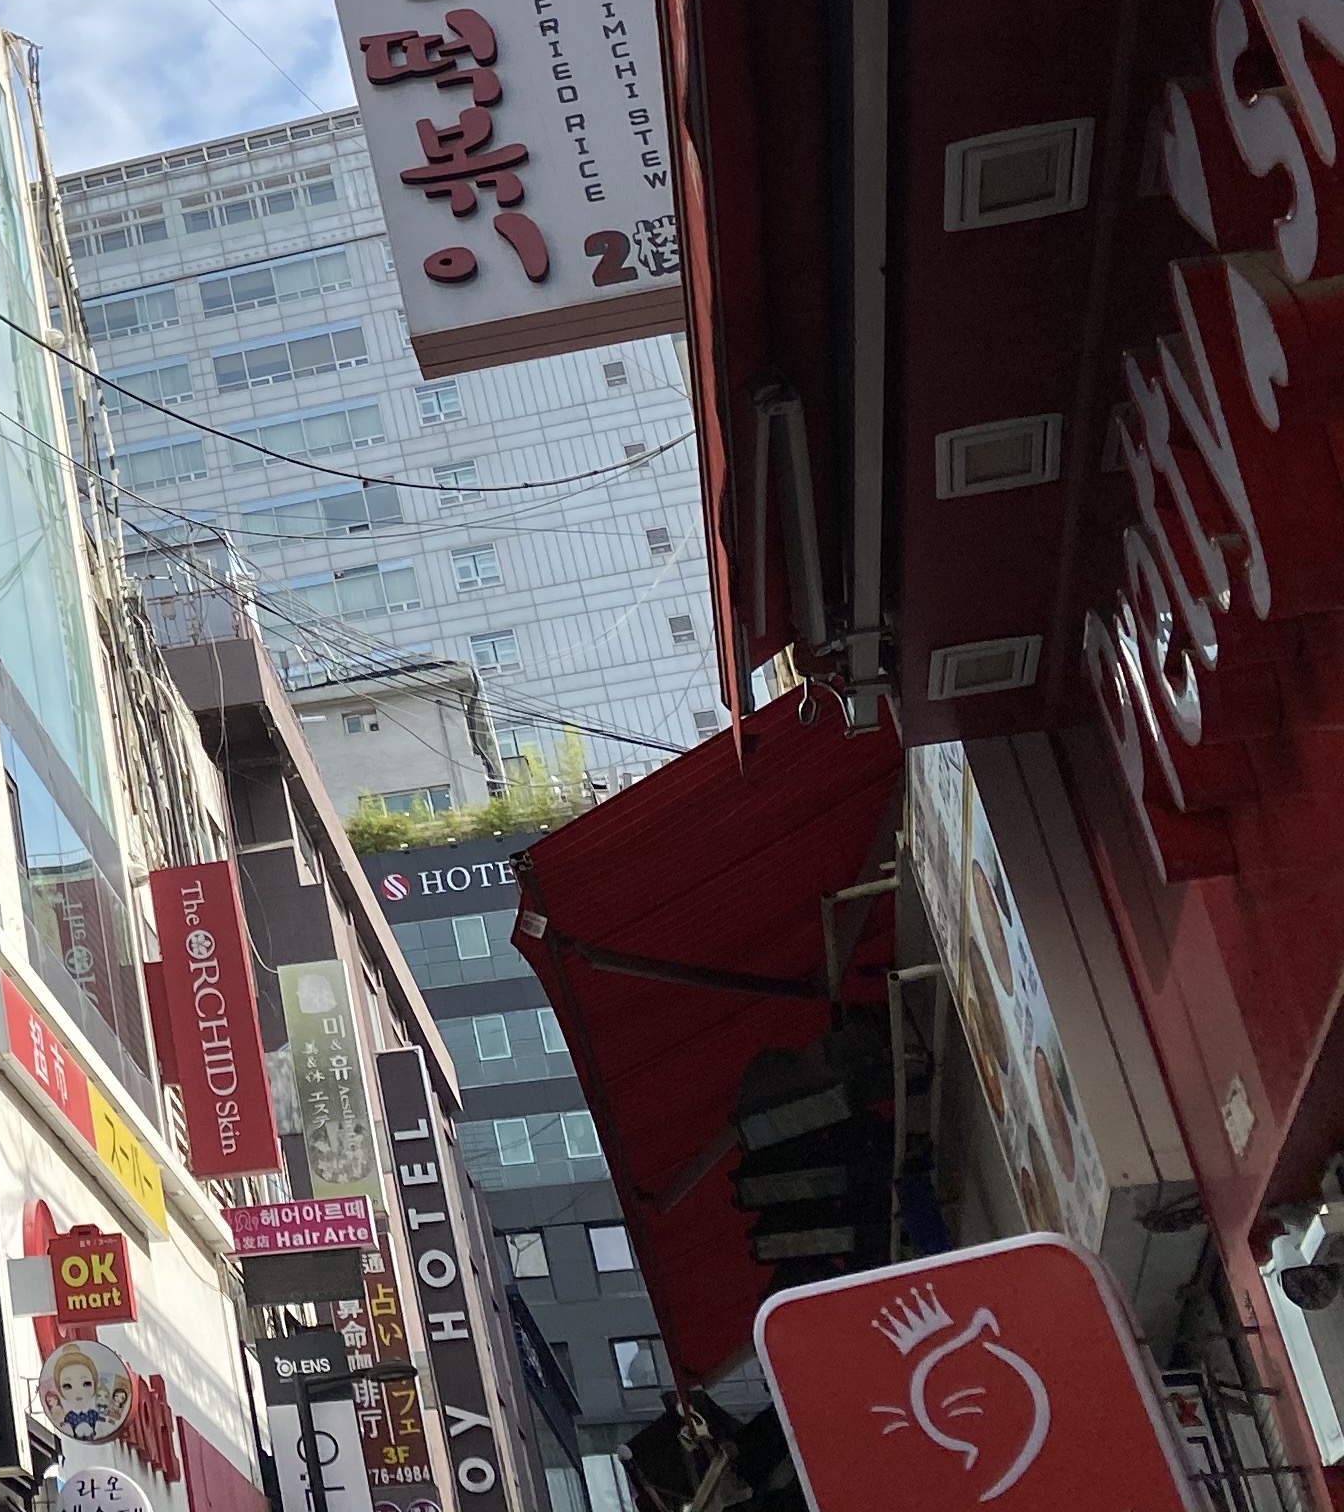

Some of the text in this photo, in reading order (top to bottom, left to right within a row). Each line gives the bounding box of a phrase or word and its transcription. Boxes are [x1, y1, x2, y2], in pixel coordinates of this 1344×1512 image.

[358, 7, 550, 284] 떡볶이
[564, 113, 607, 204] RICE
[627, 107, 669, 190] STEW
[180, 880, 206, 927] The
[214, 1100, 239, 1156] Skin
[259, 1199, 366, 1228] 헤어아르떼
[393, 1118, 470, 1342] HOTEL
[276, 1228, 322, 1248] Hair
[323, 1225, 369, 1244] Arte
[61, 1252, 118, 1287] OK
[67, 1287, 122, 1311] mart
[382, 1445, 410, 1465] 3F
[368, 1464, 431, 1485] 76-4984
